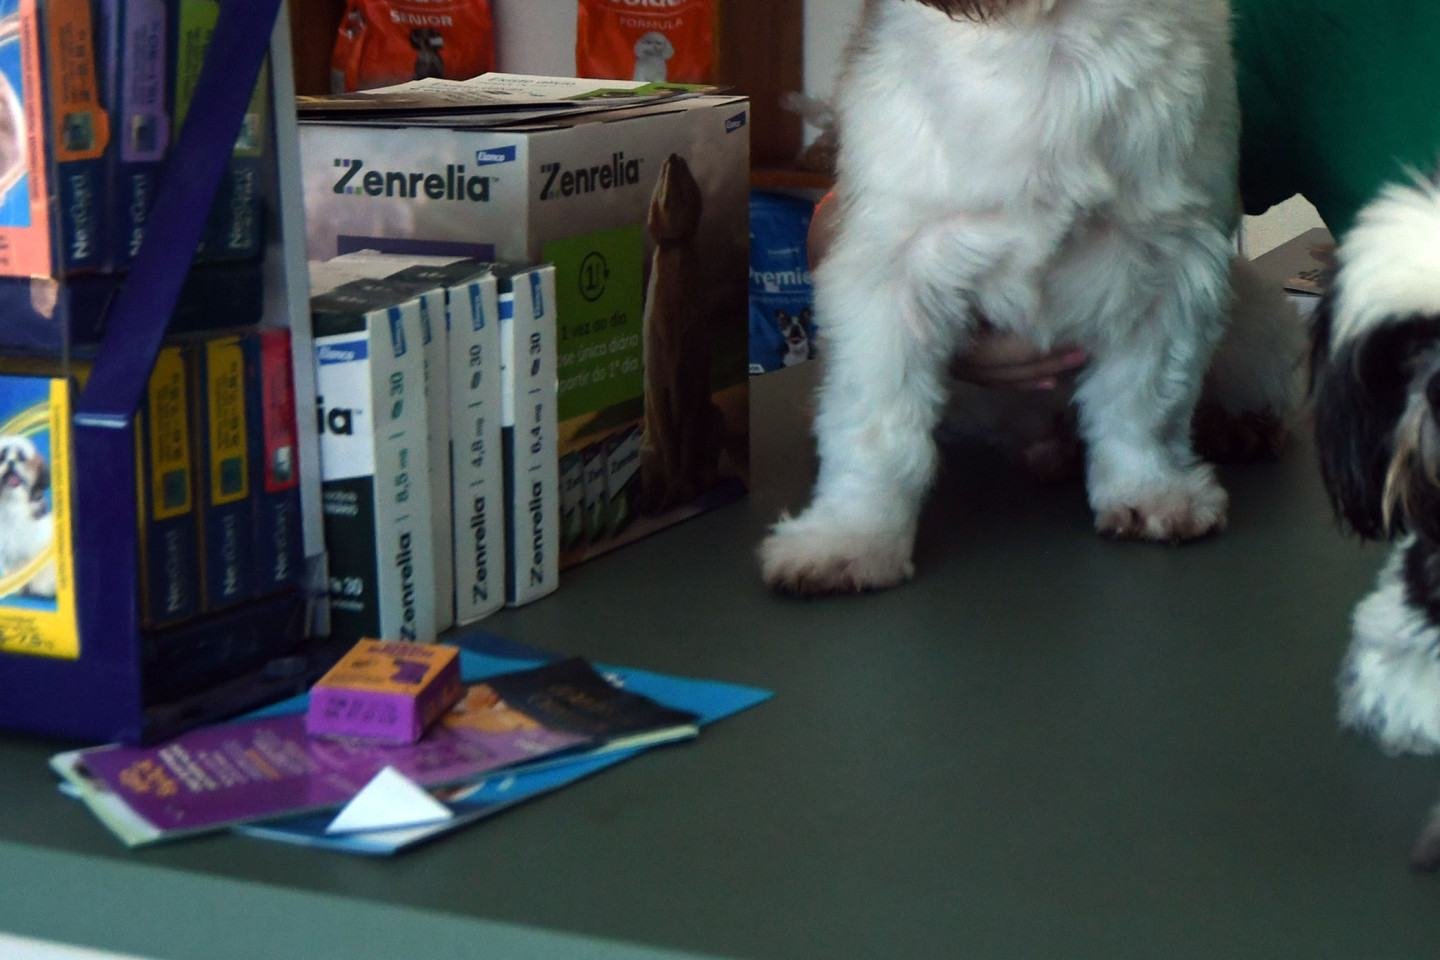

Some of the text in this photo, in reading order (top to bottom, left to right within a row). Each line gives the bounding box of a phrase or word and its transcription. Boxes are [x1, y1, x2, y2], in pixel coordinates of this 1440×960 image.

[389, 9, 454, 27] SENIOR
[619, 15, 684, 30] FORMULA
[333, 158, 490, 202] Zenrelia
[540, 151, 640, 201] Zenrelia
[469, 344, 482, 367] 30
[529, 332, 542, 354] 30
[470, 495, 488, 604] Zenrelia
[527, 481, 544, 587] Zenrelia
